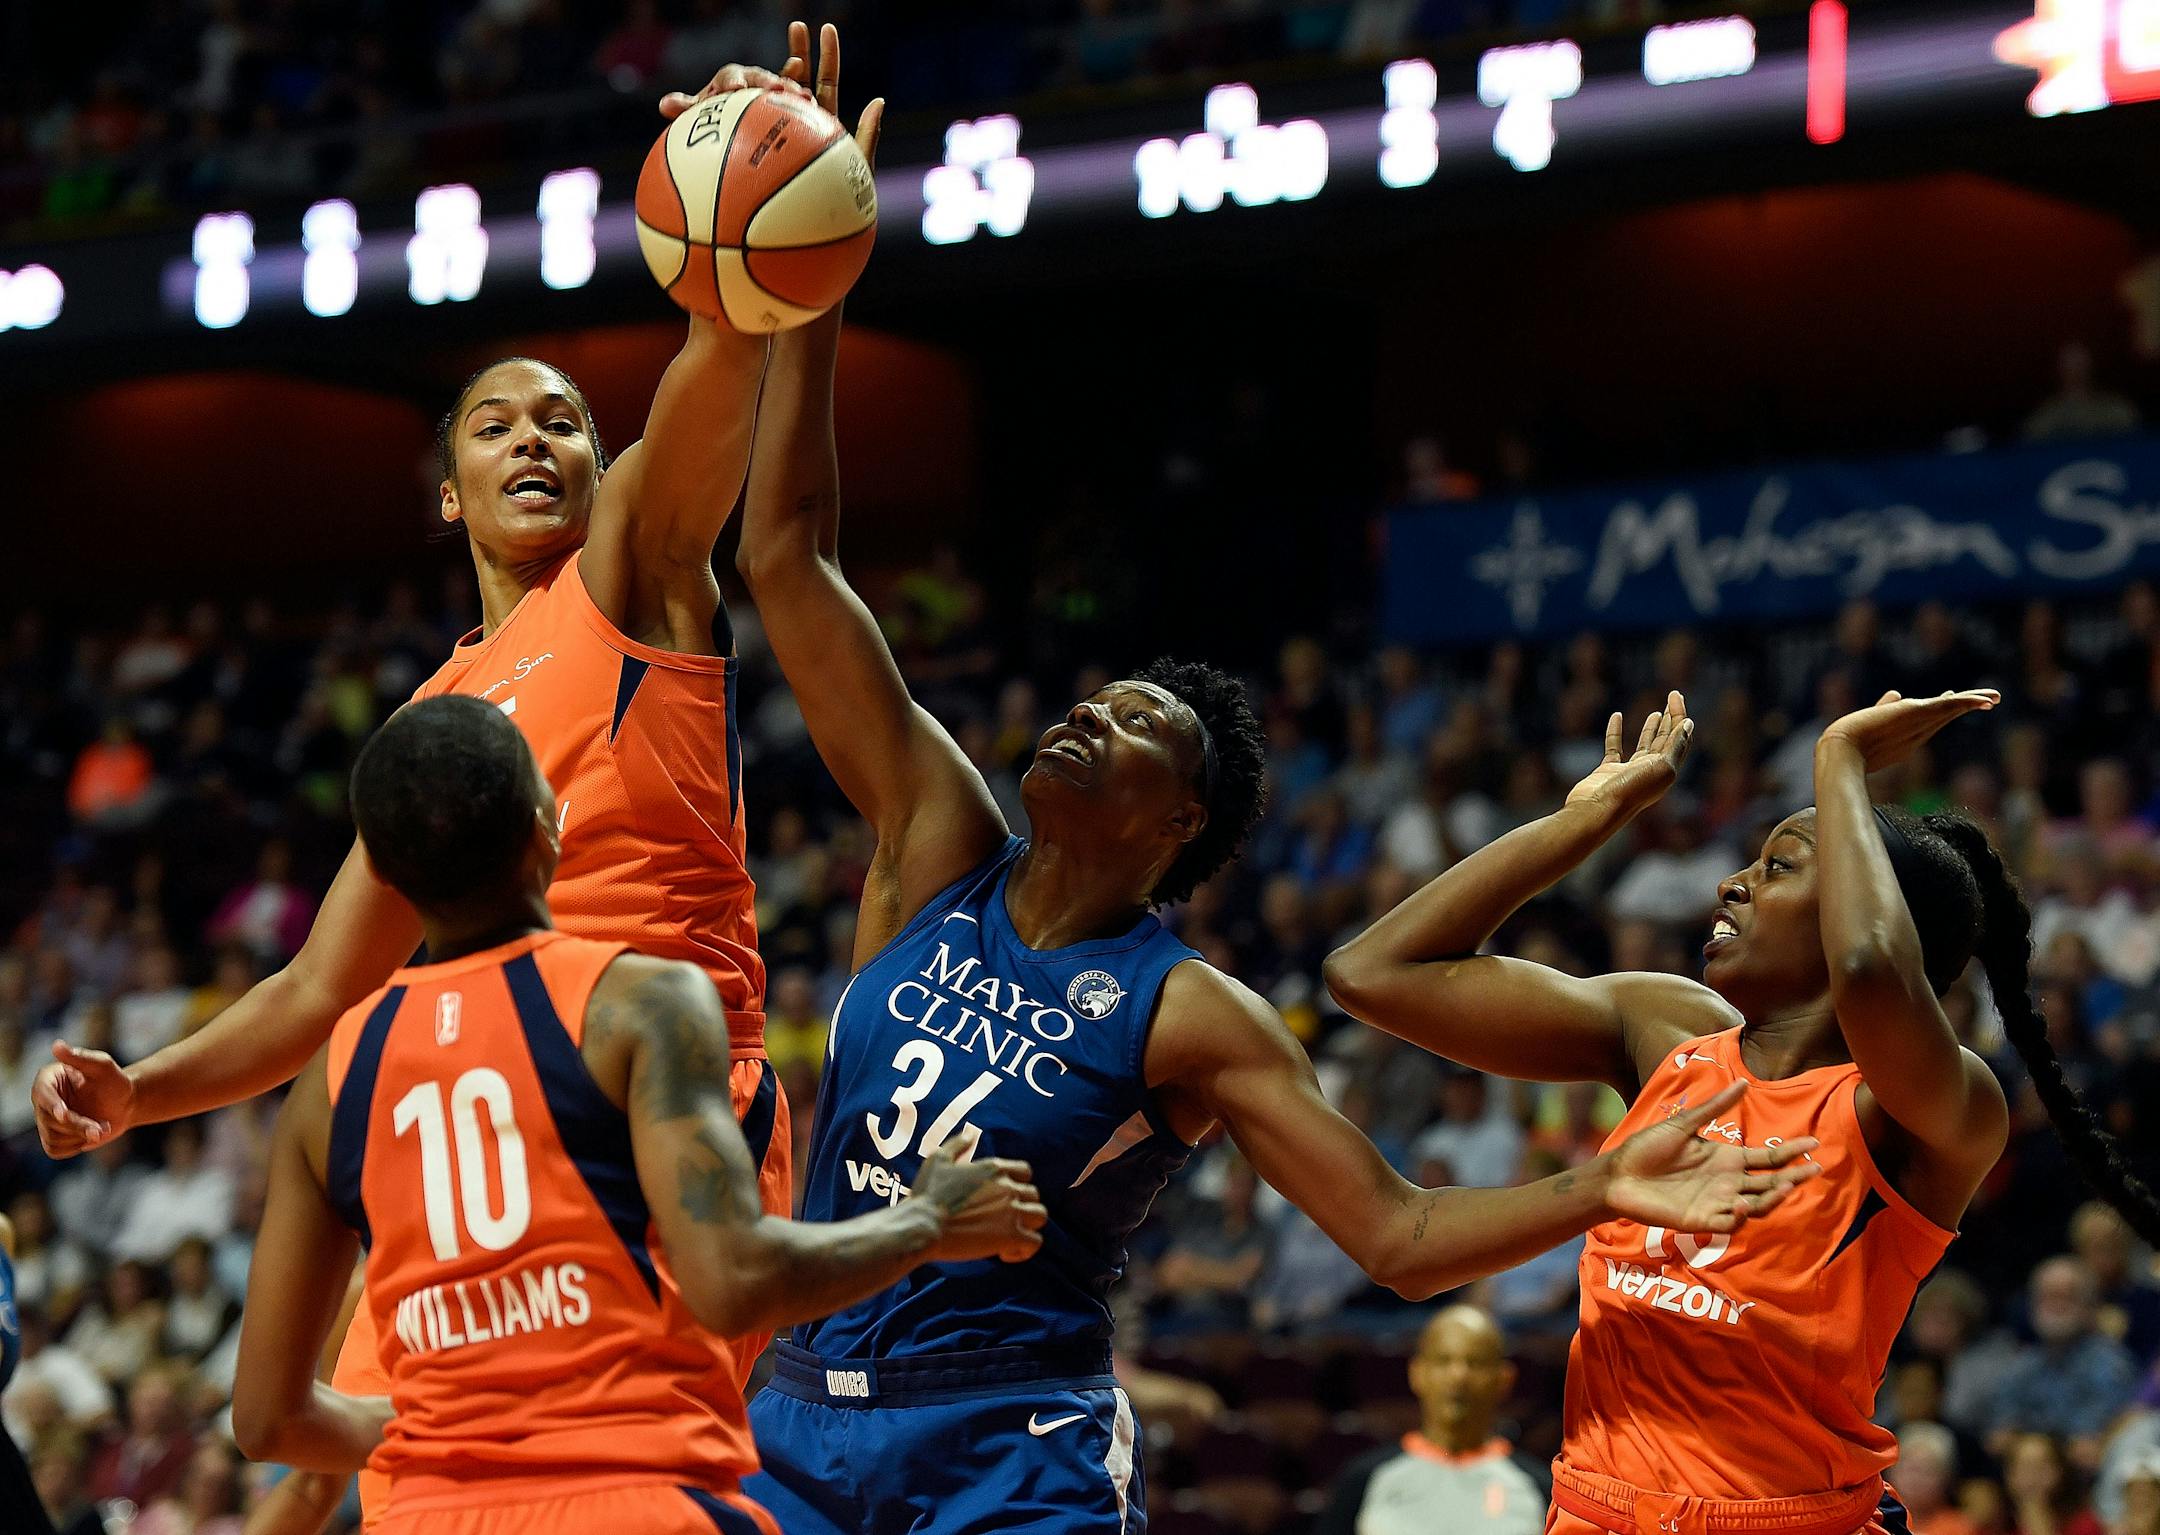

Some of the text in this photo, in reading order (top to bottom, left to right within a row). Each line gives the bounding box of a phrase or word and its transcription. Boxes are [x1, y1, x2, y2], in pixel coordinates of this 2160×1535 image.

[1586, 474, 2019, 614] Mohegan
[513, 652, 554, 681] Sun
[888, 980, 1069, 1097] CLINIC
[920, 941, 1075, 1042] MAYO
[866, 1038, 1004, 1163] 34
[392, 1066, 532, 1262] 10
[395, 1262, 592, 1355] WILLIAMS
[1605, 1258, 1741, 1326] verizon
